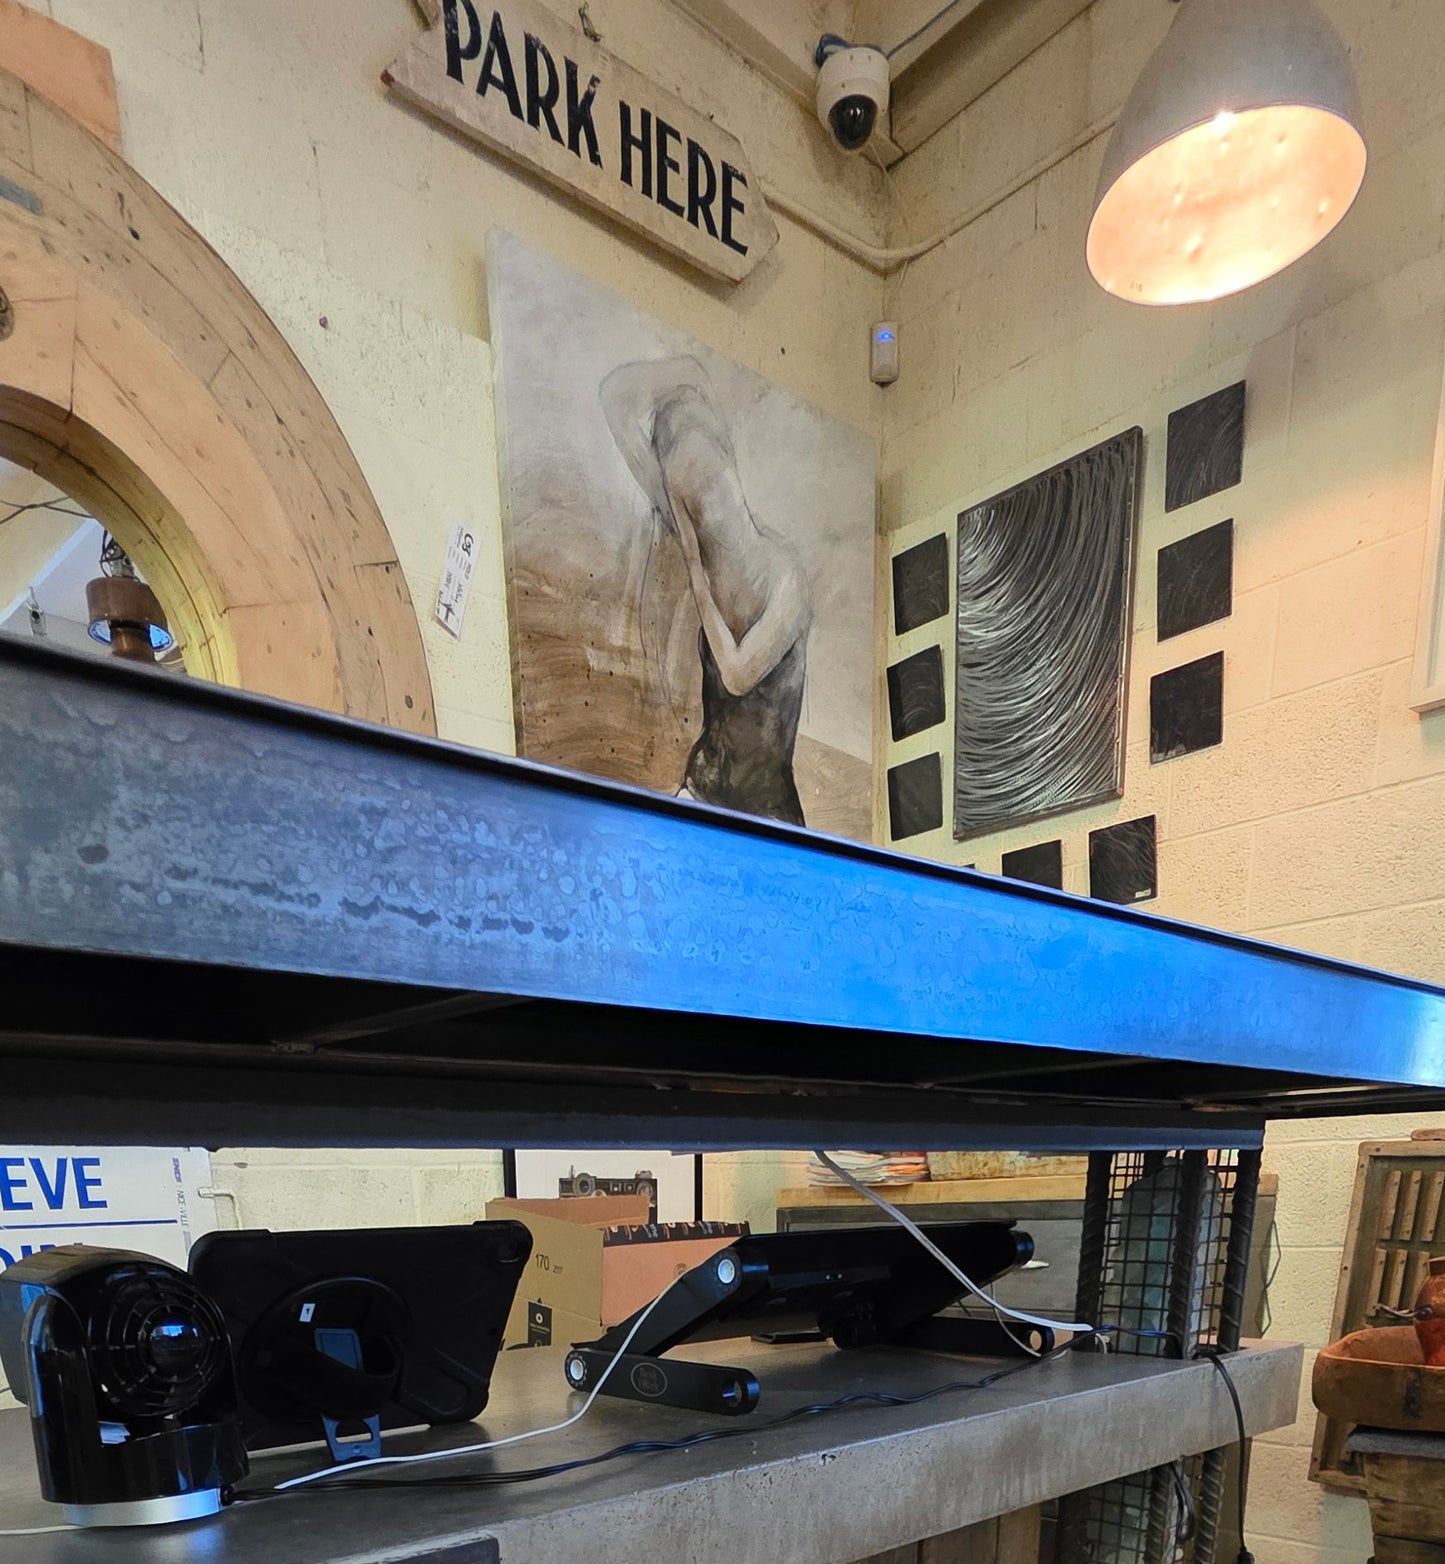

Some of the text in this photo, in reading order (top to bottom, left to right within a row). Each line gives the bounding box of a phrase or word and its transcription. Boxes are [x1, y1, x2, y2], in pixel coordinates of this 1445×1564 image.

[443, 0, 748, 256] PARK HERE
[535, 1253, 550, 1271] 170
